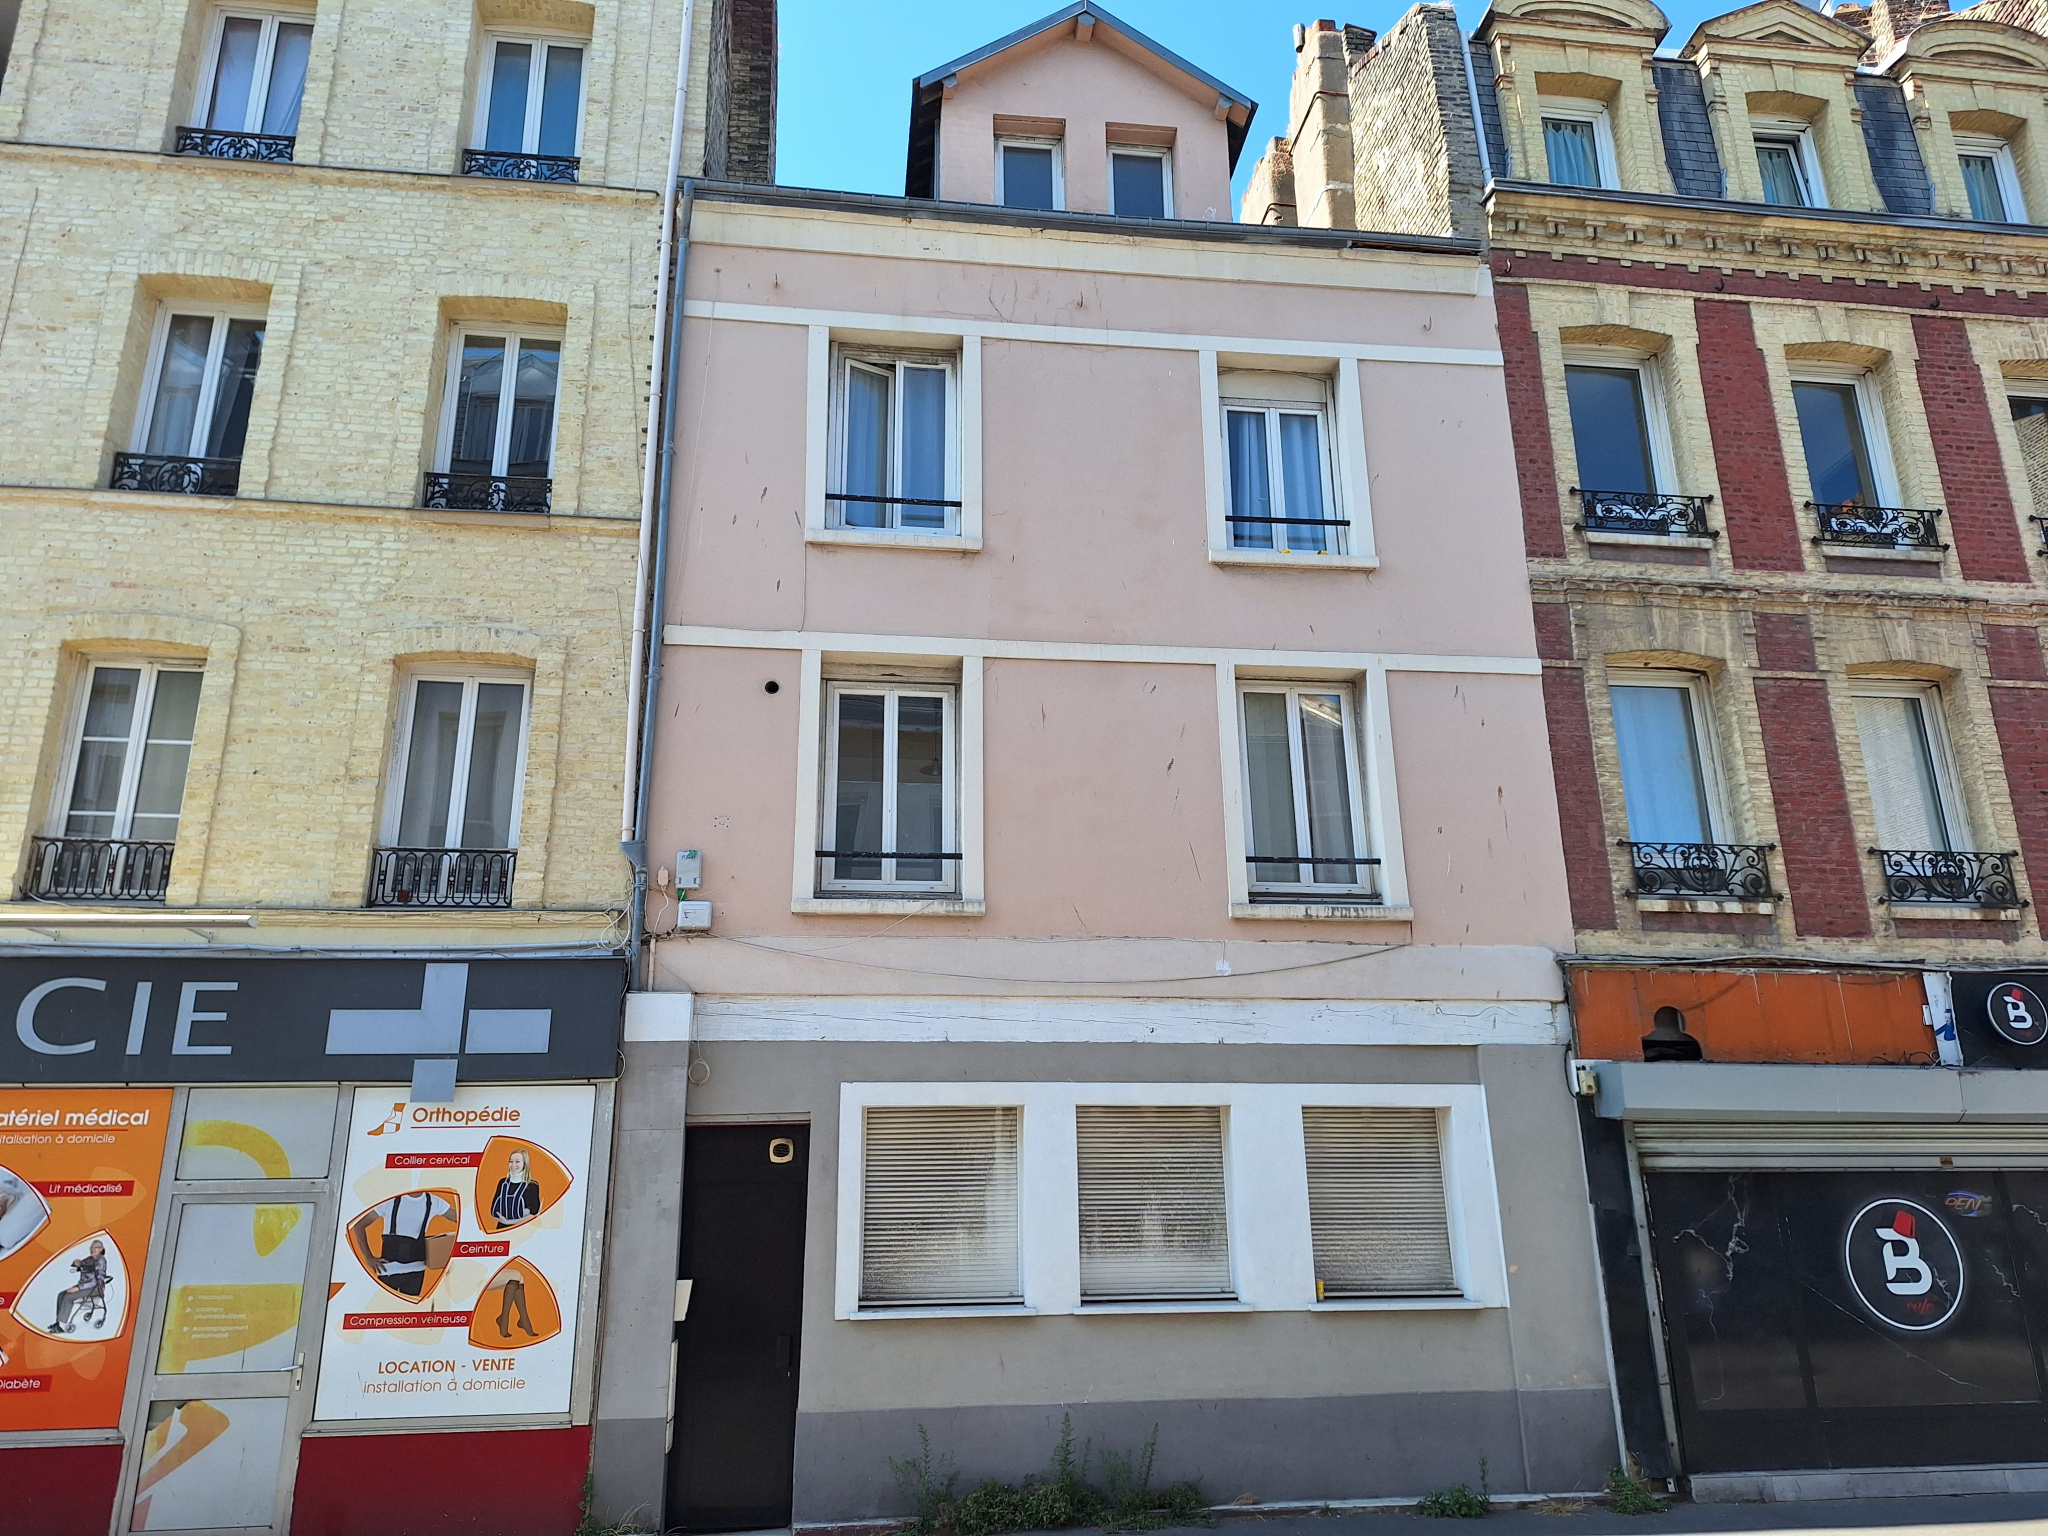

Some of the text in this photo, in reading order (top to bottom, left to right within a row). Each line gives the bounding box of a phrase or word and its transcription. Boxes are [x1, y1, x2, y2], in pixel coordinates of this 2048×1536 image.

[16, 977, 239, 1055] CIE
[65, 1108, 150, 1127] médical
[412, 1106, 521, 1126] Orthopédie
[55, 1134, 64, 1144] à
[67, 1134, 116, 1144] domicile
[394, 1155, 471, 1165] Collier cervical
[49, 1183, 123, 1194] Lit médicalisé
[1945, 1198, 1982, 1211] PEN
[460, 1244, 504, 1254] Ceinture
[1875, 1227, 1933, 1295] B
[350, 1314, 468, 1327] Compression veineuse
[378, 1360, 456, 1374] LOCATION
[472, 1358, 516, 1372] VENTE
[363, 1377, 526, 1394] installation à domicile
